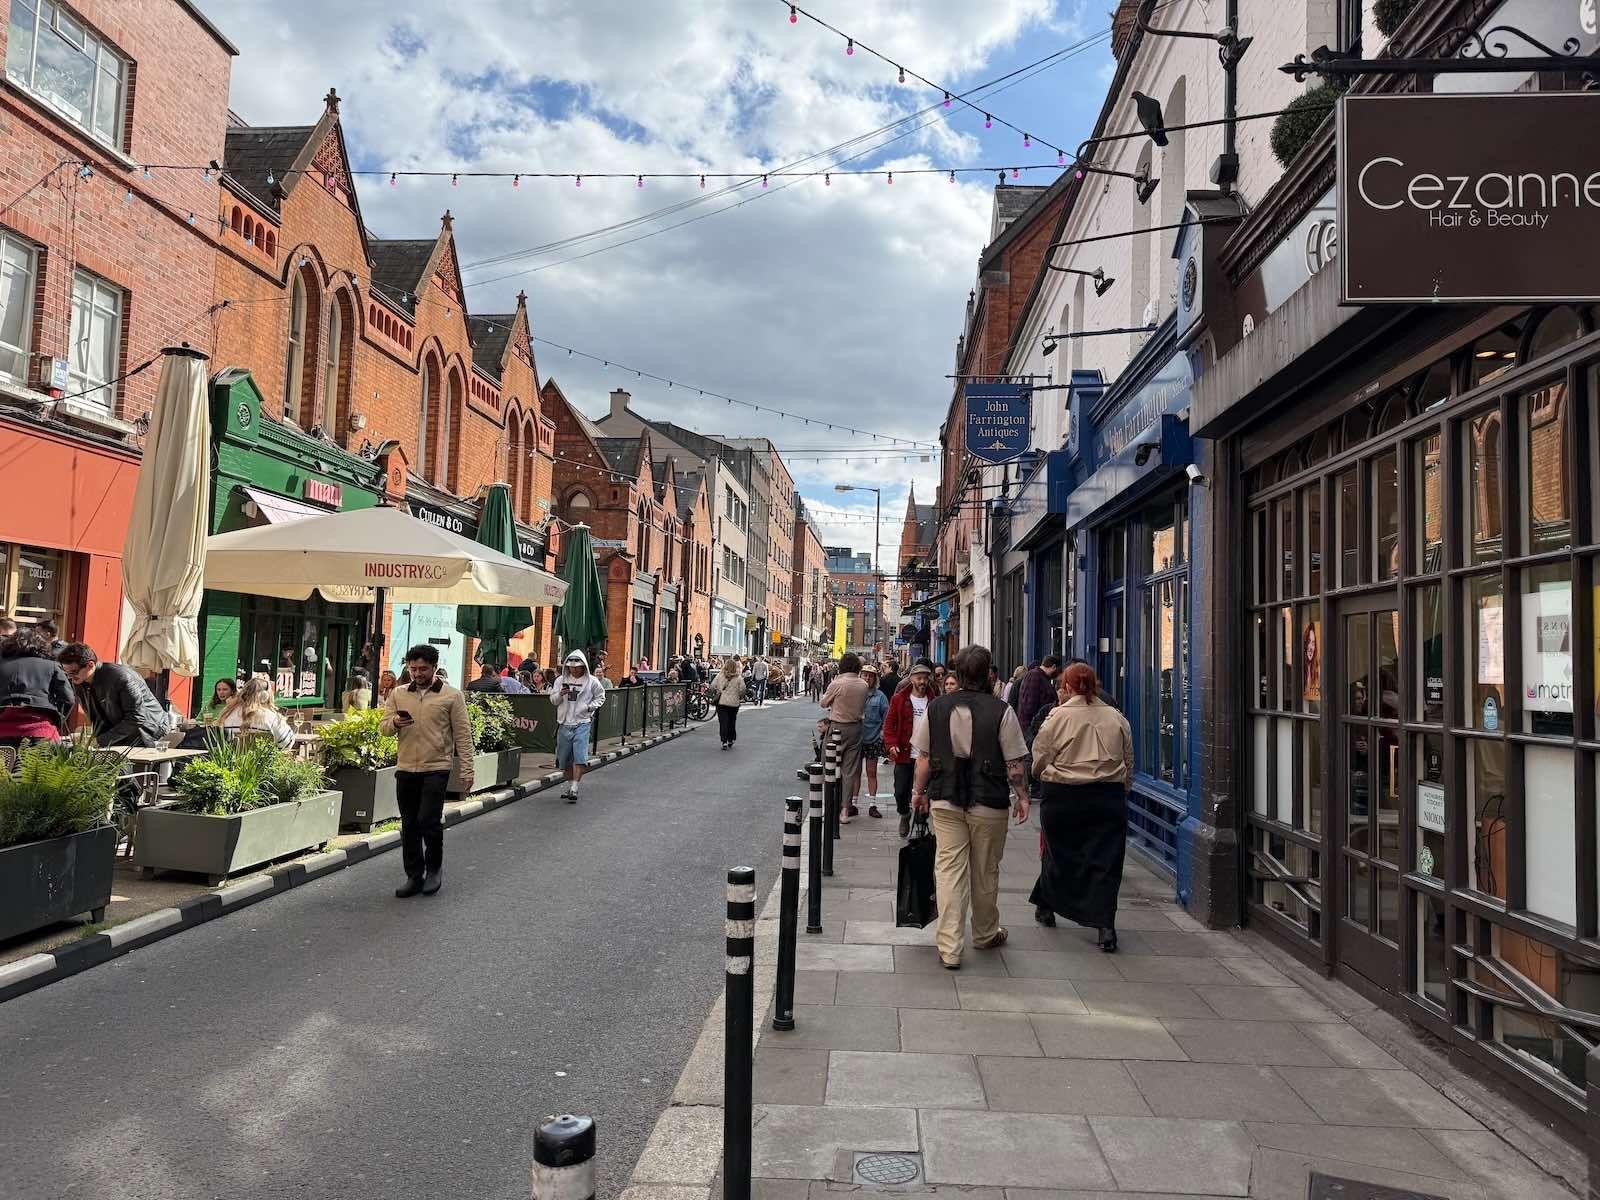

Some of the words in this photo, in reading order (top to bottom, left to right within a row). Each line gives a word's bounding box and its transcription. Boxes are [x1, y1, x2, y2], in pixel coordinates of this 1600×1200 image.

[1429, 210, 1463, 228] Hair
[1469, 210, 1481, 226] &
[1488, 210, 1549, 229] Beauty
[985, 401, 1009, 412] John
[968, 414, 1026, 426] Farrington
[978, 427, 1019, 438] Antiques
